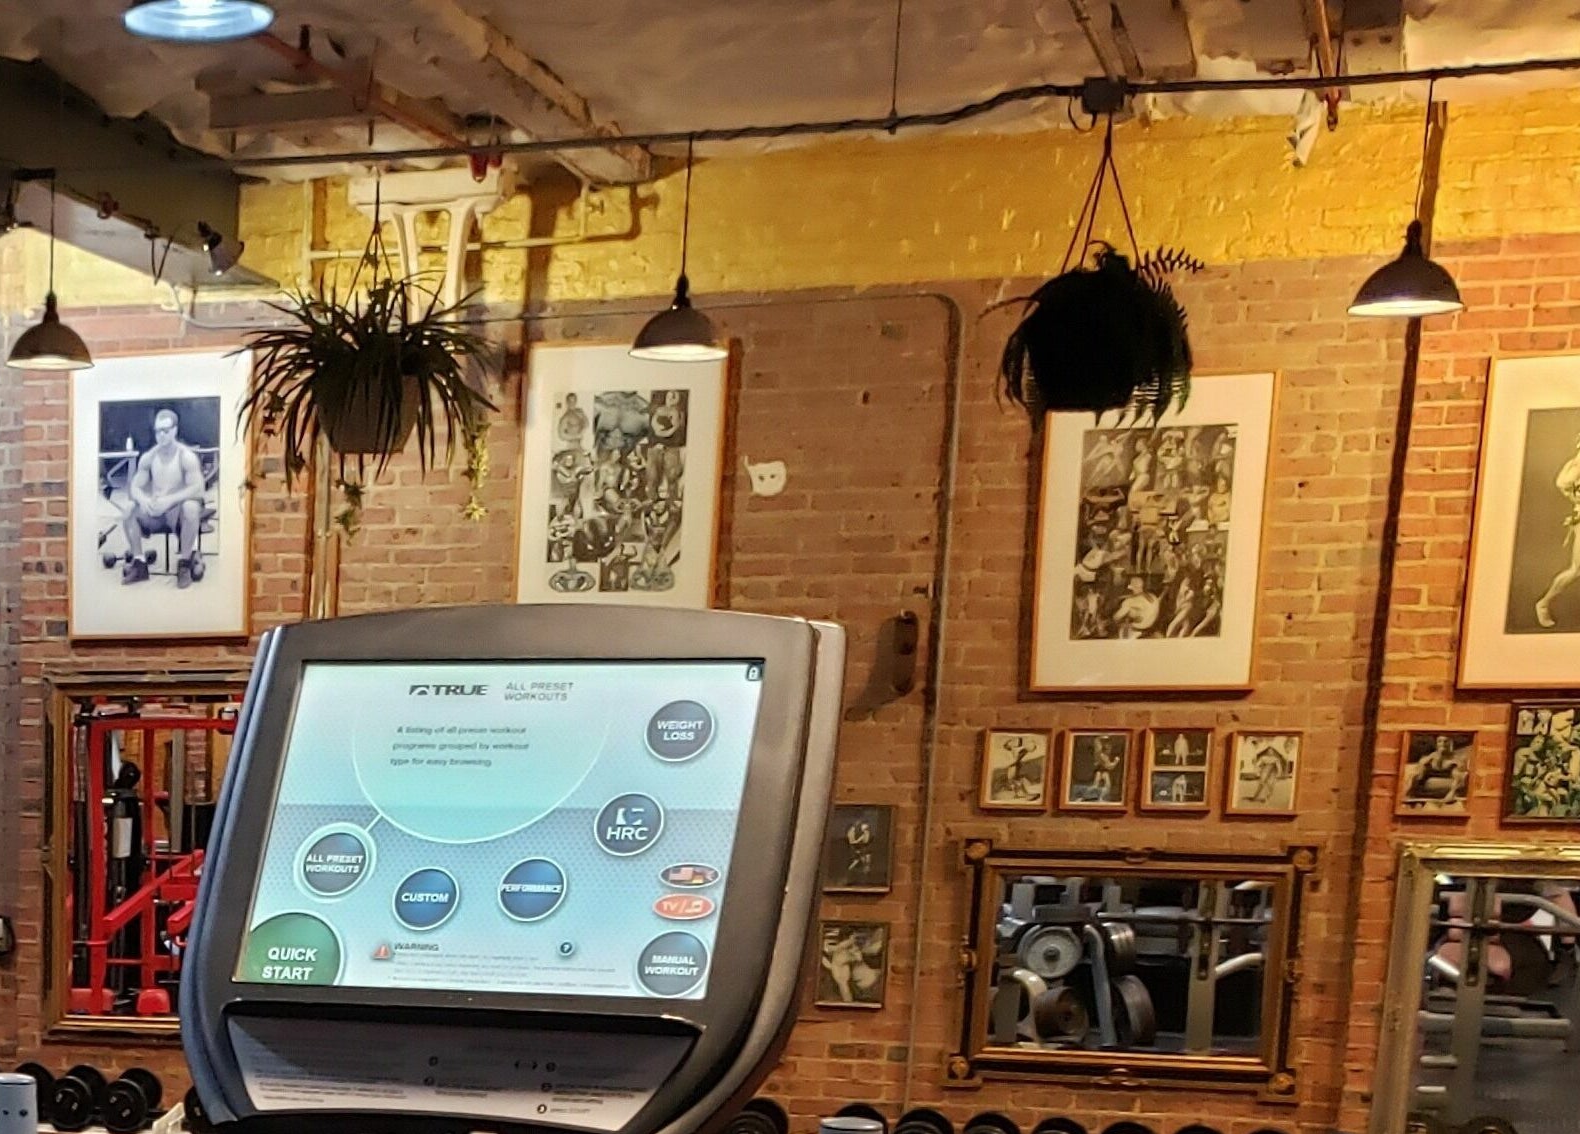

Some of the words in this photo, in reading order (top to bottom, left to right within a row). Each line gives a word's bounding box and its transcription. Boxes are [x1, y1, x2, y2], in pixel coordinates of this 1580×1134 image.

[432, 684, 489, 696] TRUE
[506, 682, 526, 691] ALL
[531, 682, 574, 691] PRESET
[504, 692, 568, 701] WORKOUTS
[434, 726, 445, 734] of
[657, 720, 704, 730] WEIGHT
[663, 731, 695, 741] LOSS
[411, 757, 424, 765] for
[606, 826, 649, 840] HRC
[306, 855, 323, 863] ALL
[327, 855, 364, 864] PRESET
[306, 864, 361, 874] WORKOUTS
[500, 884, 563, 894] PERFORMANCE
[401, 892, 450, 903] CUSTOM
[394, 943, 440, 952] WARNING
[268, 947, 318, 962] QUICK
[651, 955, 696, 965] MANUAL
[262, 966, 313, 981] START
[644, 966, 699, 977] WORKOUT
